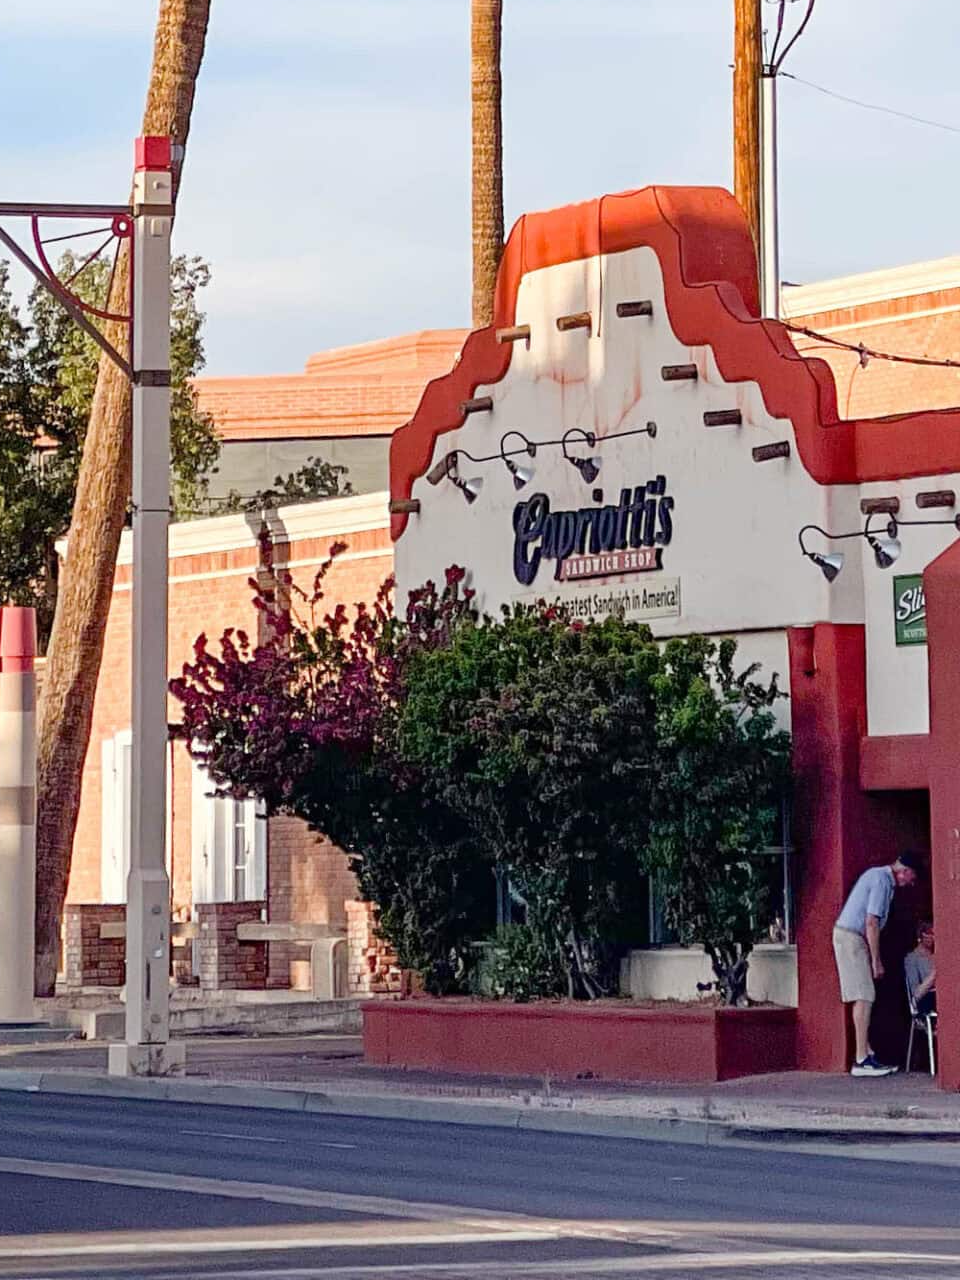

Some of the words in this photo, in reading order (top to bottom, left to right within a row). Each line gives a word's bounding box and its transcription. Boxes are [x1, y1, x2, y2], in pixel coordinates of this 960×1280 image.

[513, 475, 674, 585] Capriotti's
[566, 556, 619, 576] SANDWICH
[624, 551, 651, 569] SHOP
[632, 588, 641, 610] in
[642, 584, 678, 609] America!
